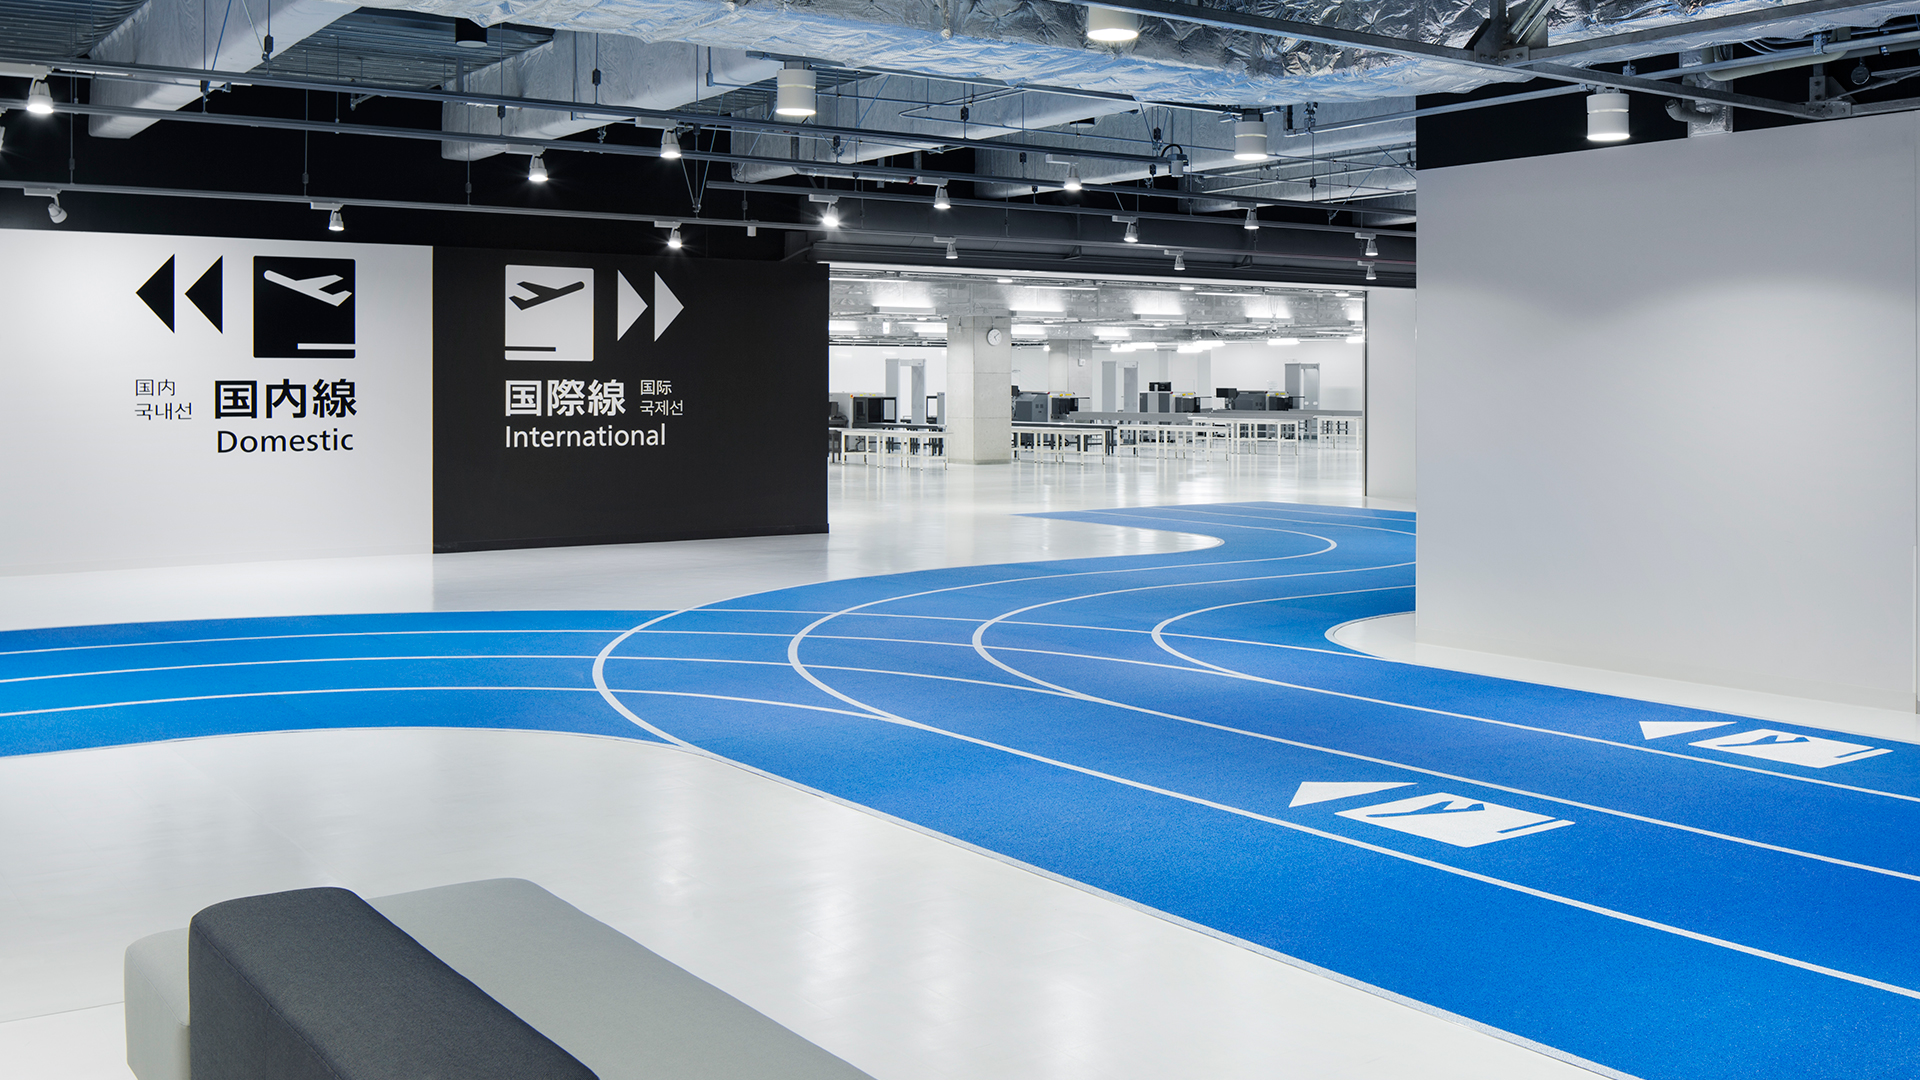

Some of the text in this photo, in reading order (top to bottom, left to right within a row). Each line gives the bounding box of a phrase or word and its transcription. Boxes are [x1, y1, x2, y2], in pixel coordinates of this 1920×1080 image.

[135, 379, 175, 397] 国内
[640, 379, 673, 395] 国际
[214, 378, 358, 419] 国内線
[505, 379, 626, 417] 国際線
[639, 399, 684, 416] 국제선
[134, 402, 193, 420] 국내선
[217, 428, 354, 453] Domestic
[505, 423, 666, 448] International
